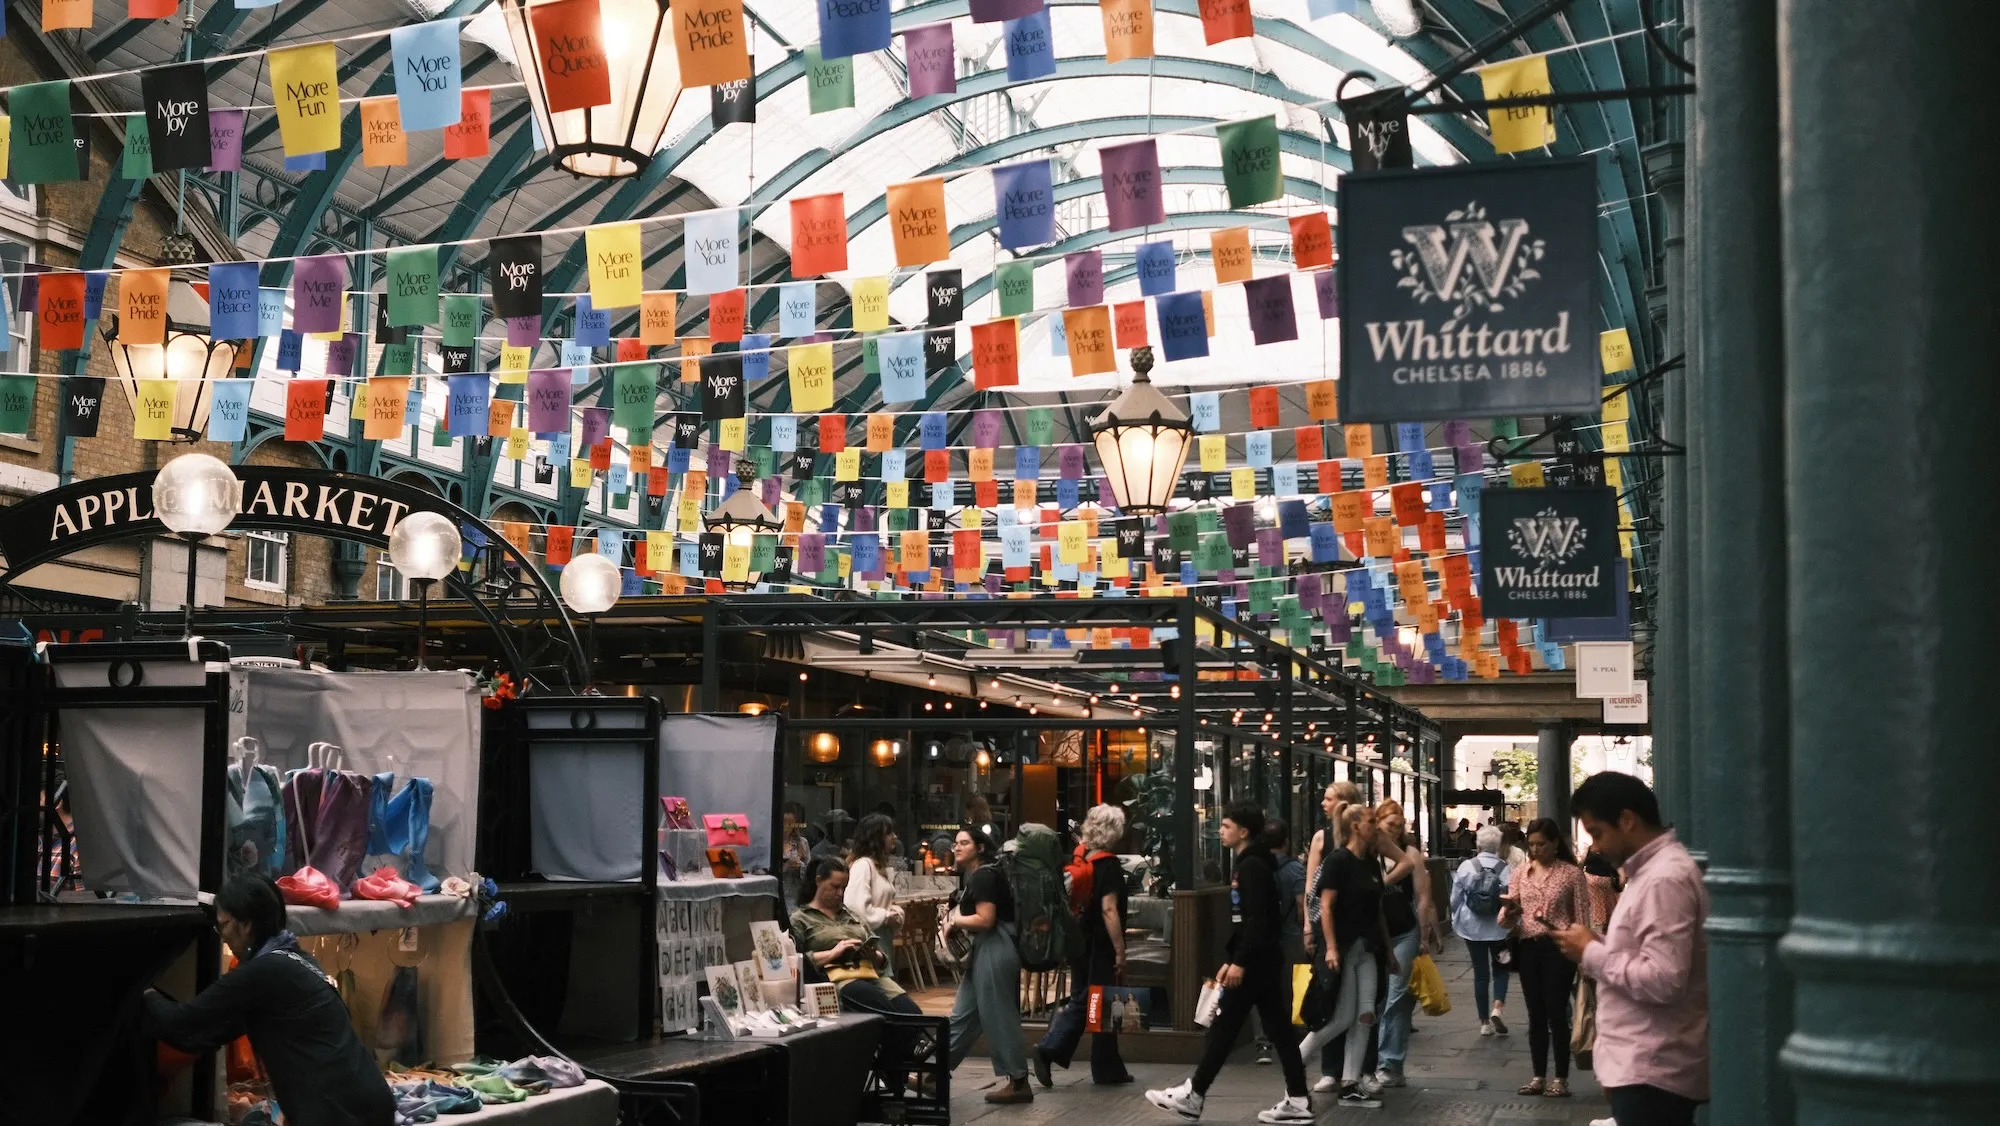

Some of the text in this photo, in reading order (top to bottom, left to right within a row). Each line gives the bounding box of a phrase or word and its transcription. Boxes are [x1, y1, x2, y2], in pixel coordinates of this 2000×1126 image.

[827, 0, 880, 20] Peace
[685, 8, 732, 31] More
[1110, 11, 1142, 24] More
[1011, 27, 1044, 43] More
[1112, 23, 1142, 37] Pride
[689, 29, 733, 52] Pride
[912, 47, 946, 62] More
[1011, 41, 1045, 56] Peace
[407, 54, 451, 75] More
[814, 63, 844, 79] More
[920, 60, 941, 72] Me
[417, 74, 447, 92] You
[816, 75, 843, 87] Love
[287, 80, 328, 101] More
[722, 88, 740, 103] Joy
[157, 99, 198, 118] More
[297, 99, 326, 118] Fun
[1508, 105, 1536, 122] Fun
[24, 114, 63, 131] More
[167, 116, 188, 137] Joy
[368, 120, 398, 133] More
[449, 122, 483, 137] Queer
[29, 130, 63, 146] Love
[368, 131, 396, 146] Pride
[1232, 144, 1272, 163] More
[1236, 157, 1272, 176] Love
[1113, 169, 1151, 185] More
[1005, 188, 1043, 205] More
[1122, 186, 1147, 203] Me
[899, 206, 936, 222] More
[1005, 203, 1046, 220] Peace
[801, 218, 836, 232] More
[902, 220, 937, 238] Pride
[694, 236, 729, 253] More
[796, 230, 840, 250] Queer
[700, 252, 726, 265] You
[1219, 247, 1246, 258] More
[598, 253, 633, 267] More
[1144, 258, 1168, 268] More
[1220, 257, 1244, 268] Pride
[500, 262, 534, 278] More
[605, 266, 629, 280] Fun
[1143, 266, 1170, 277] Peace
[397, 273, 430, 285] More
[510, 274, 528, 291] Joy
[1003, 278, 1028, 289] More
[304, 279, 335, 293] More
[399, 284, 428, 298] Love
[931, 286, 957, 298] More
[1005, 286, 1027, 297] Love
[129, 292, 159, 306] More
[218, 288, 251, 301] More
[310, 294, 331, 308] Me
[859, 294, 882, 305] More
[938, 294, 952, 307] Joy
[48, 297, 77, 310] More
[217, 301, 251, 314] Peace
[259, 302, 279, 313] More
[786, 300, 809, 310] More
[863, 304, 879, 313] Fun
[45, 308, 80, 325] Queer
[130, 305, 159, 321] Pride
[261, 311, 274, 320] You
[450, 312, 472, 321] More
[582, 311, 604, 321] More
[646, 309, 669, 319] More
[714, 305, 740, 316] More
[791, 310, 807, 319] You
[452, 320, 471, 328] Love
[581, 320, 604, 329] Peace
[647, 318, 668, 328] Pride
[712, 314, 740, 324] Queer
[518, 322, 532, 330] Me
[930, 335, 951, 346] More
[1074, 330, 1105, 341] More
[1364, 310, 1572, 363] Whittard
[934, 342, 947, 352] Joy
[980, 342, 1008, 355] More
[1076, 340, 1105, 354] Pride
[447, 352, 467, 361] More
[452, 358, 462, 368] Joy
[887, 355, 917, 368] More
[509, 360, 522, 368] Fun
[797, 365, 826, 378] More
[894, 367, 915, 379] You
[1391, 359, 1548, 385] CHELSEA 1886
[708, 376, 737, 389] More
[803, 377, 822, 388] Fun
[536, 390, 564, 401] More
[621, 385, 650, 396] More
[714, 385, 731, 399] Joy
[4, 394, 27, 403] More
[72, 395, 96, 407] More
[144, 397, 168, 409] More
[294, 399, 320, 410] More
[374, 396, 400, 408] More
[455, 395, 483, 405] More
[623, 394, 648, 404] Love
[5, 403, 25, 412] Love
[78, 405, 91, 417] Joy
[216, 400, 242, 411] More
[454, 404, 483, 416] Peace
[541, 401, 559, 412] Me
[1194, 404, 1214, 412] More
[148, 407, 165, 419] Fun
[222, 409, 239, 421] You
[290, 409, 320, 421] Queer
[374, 407, 398, 420] Pride
[678, 423, 696, 433] More
[683, 430, 692, 438] Joy
[797, 456, 813, 464] More
[800, 461, 808, 469] Joy
[50, 480, 410, 541] APPLE MARKET
[1120, 530, 1139, 539] More
[1125, 537, 1135, 545] Joy
[702, 543, 720, 551] More
[706, 550, 716, 558] Joy
[1494, 566, 1600, 589] Whittard
[1508, 588, 1588, 601] CHELSEA 1886
